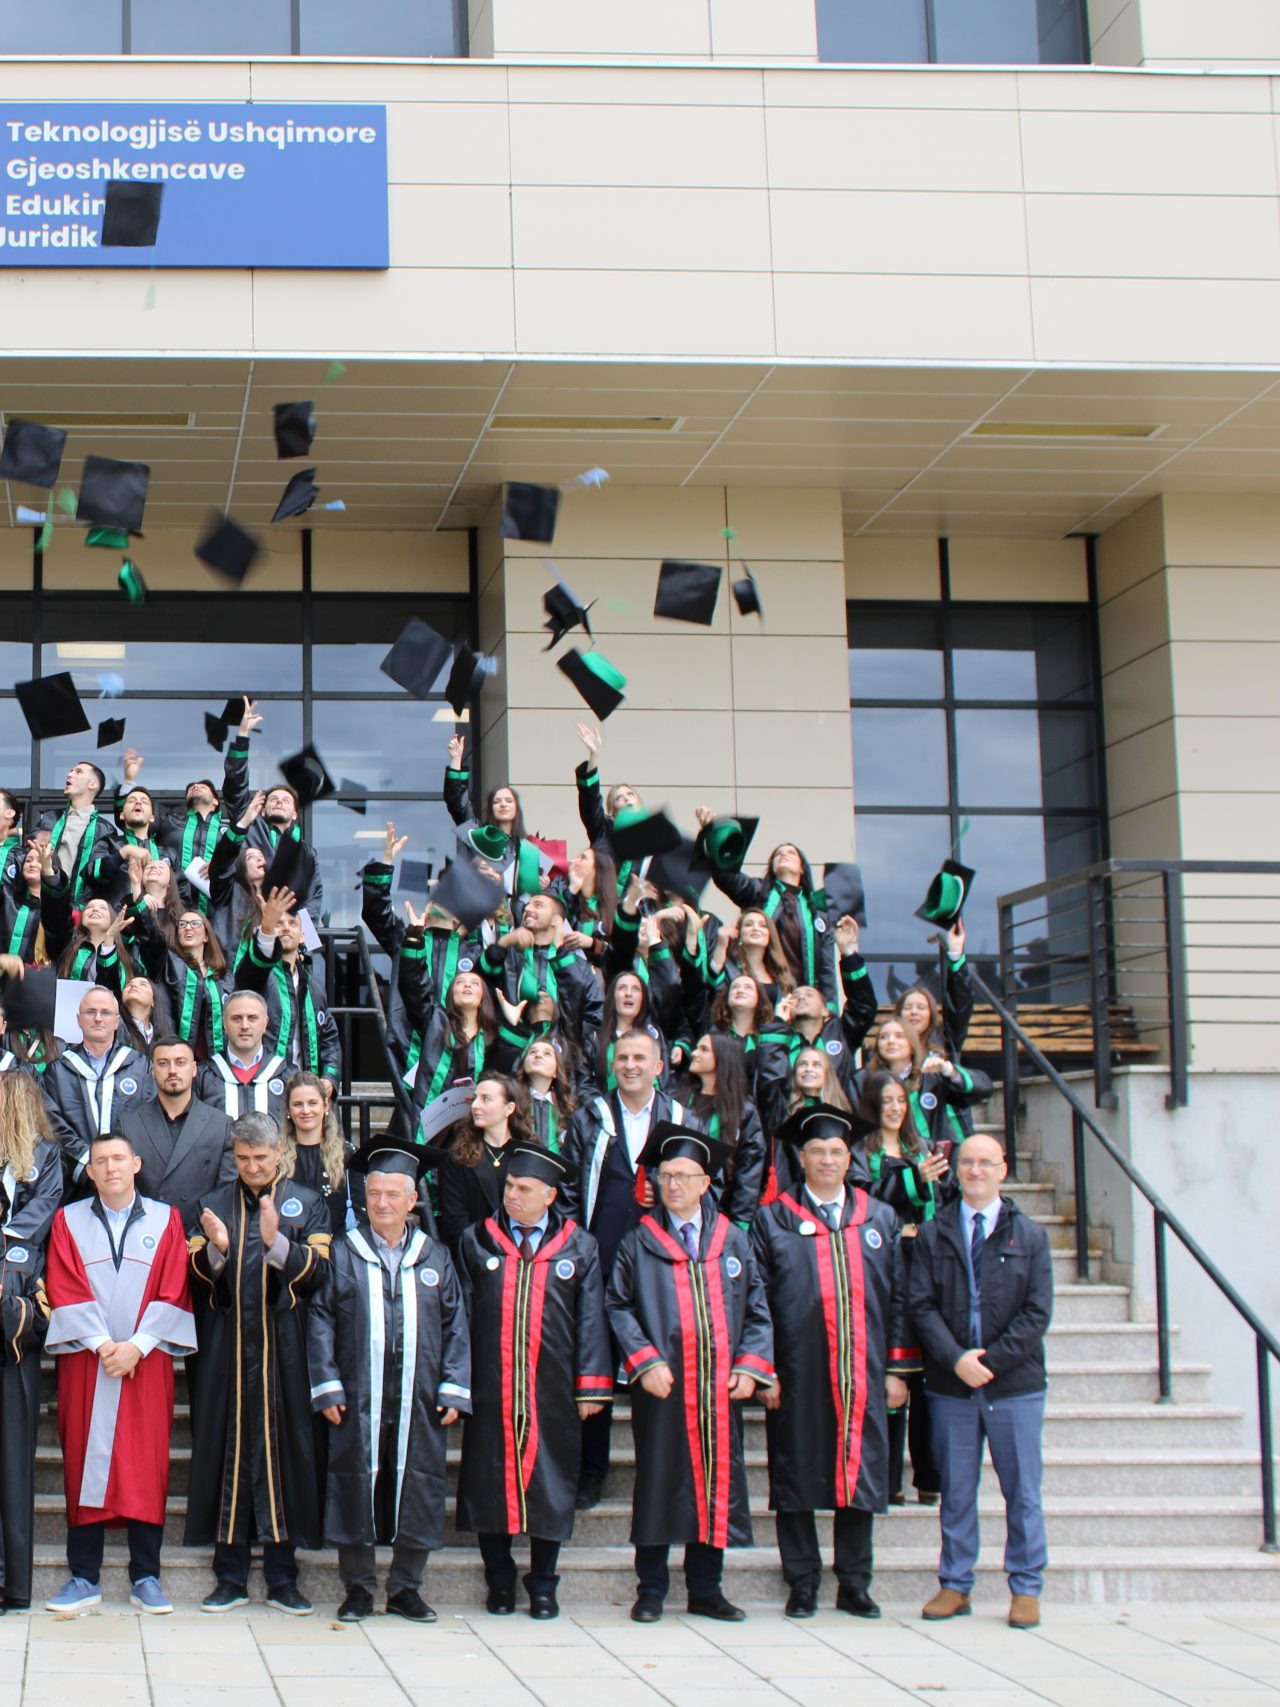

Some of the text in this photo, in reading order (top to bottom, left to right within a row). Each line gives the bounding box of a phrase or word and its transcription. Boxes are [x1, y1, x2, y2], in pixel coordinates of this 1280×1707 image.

[6, 118, 202, 149] Teknologjisë
[208, 119, 376, 149] Ushqimore
[6, 156, 245, 186] Gjeoshkencave
